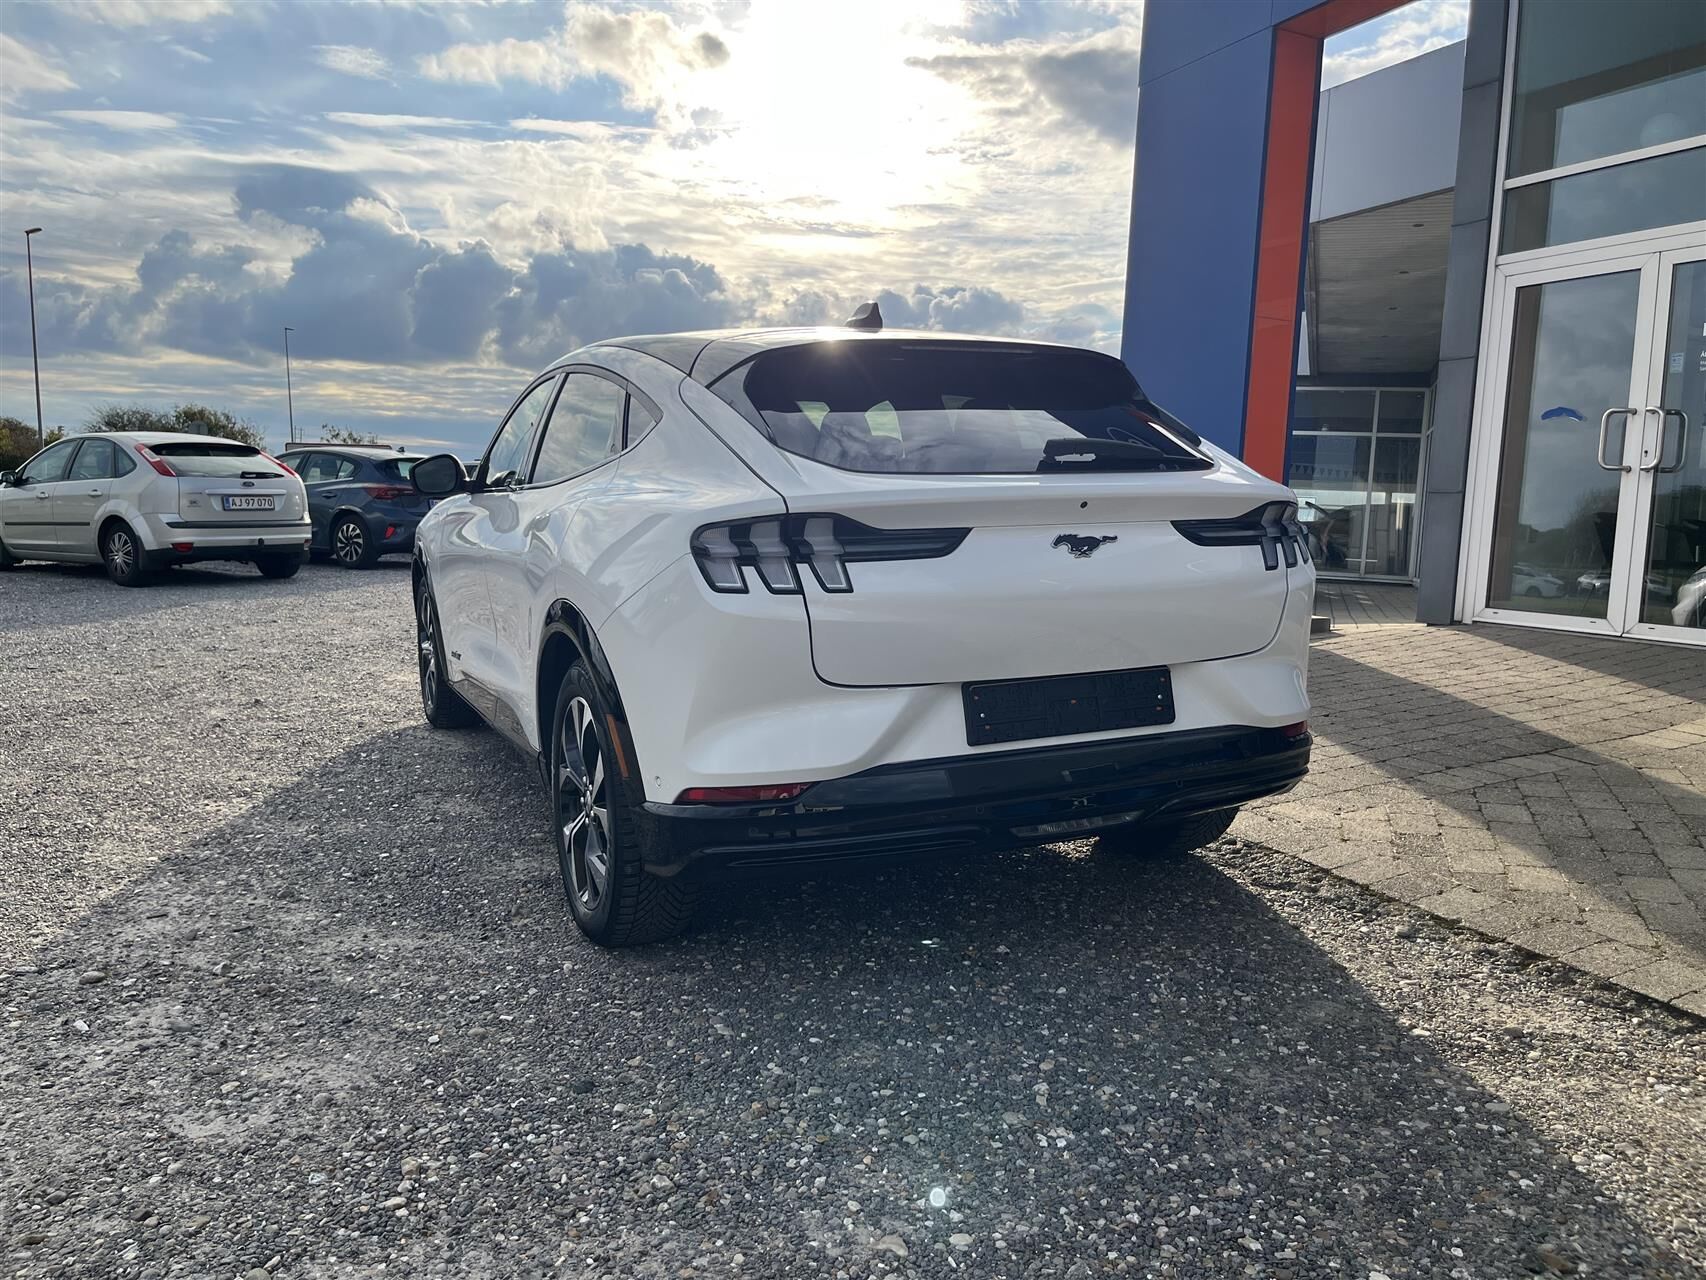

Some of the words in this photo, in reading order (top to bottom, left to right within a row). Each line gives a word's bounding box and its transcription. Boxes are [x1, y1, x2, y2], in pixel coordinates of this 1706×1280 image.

[231, 496, 243, 507] AJ
[244, 496, 255, 507] 97
[257, 496, 273, 507] 070
